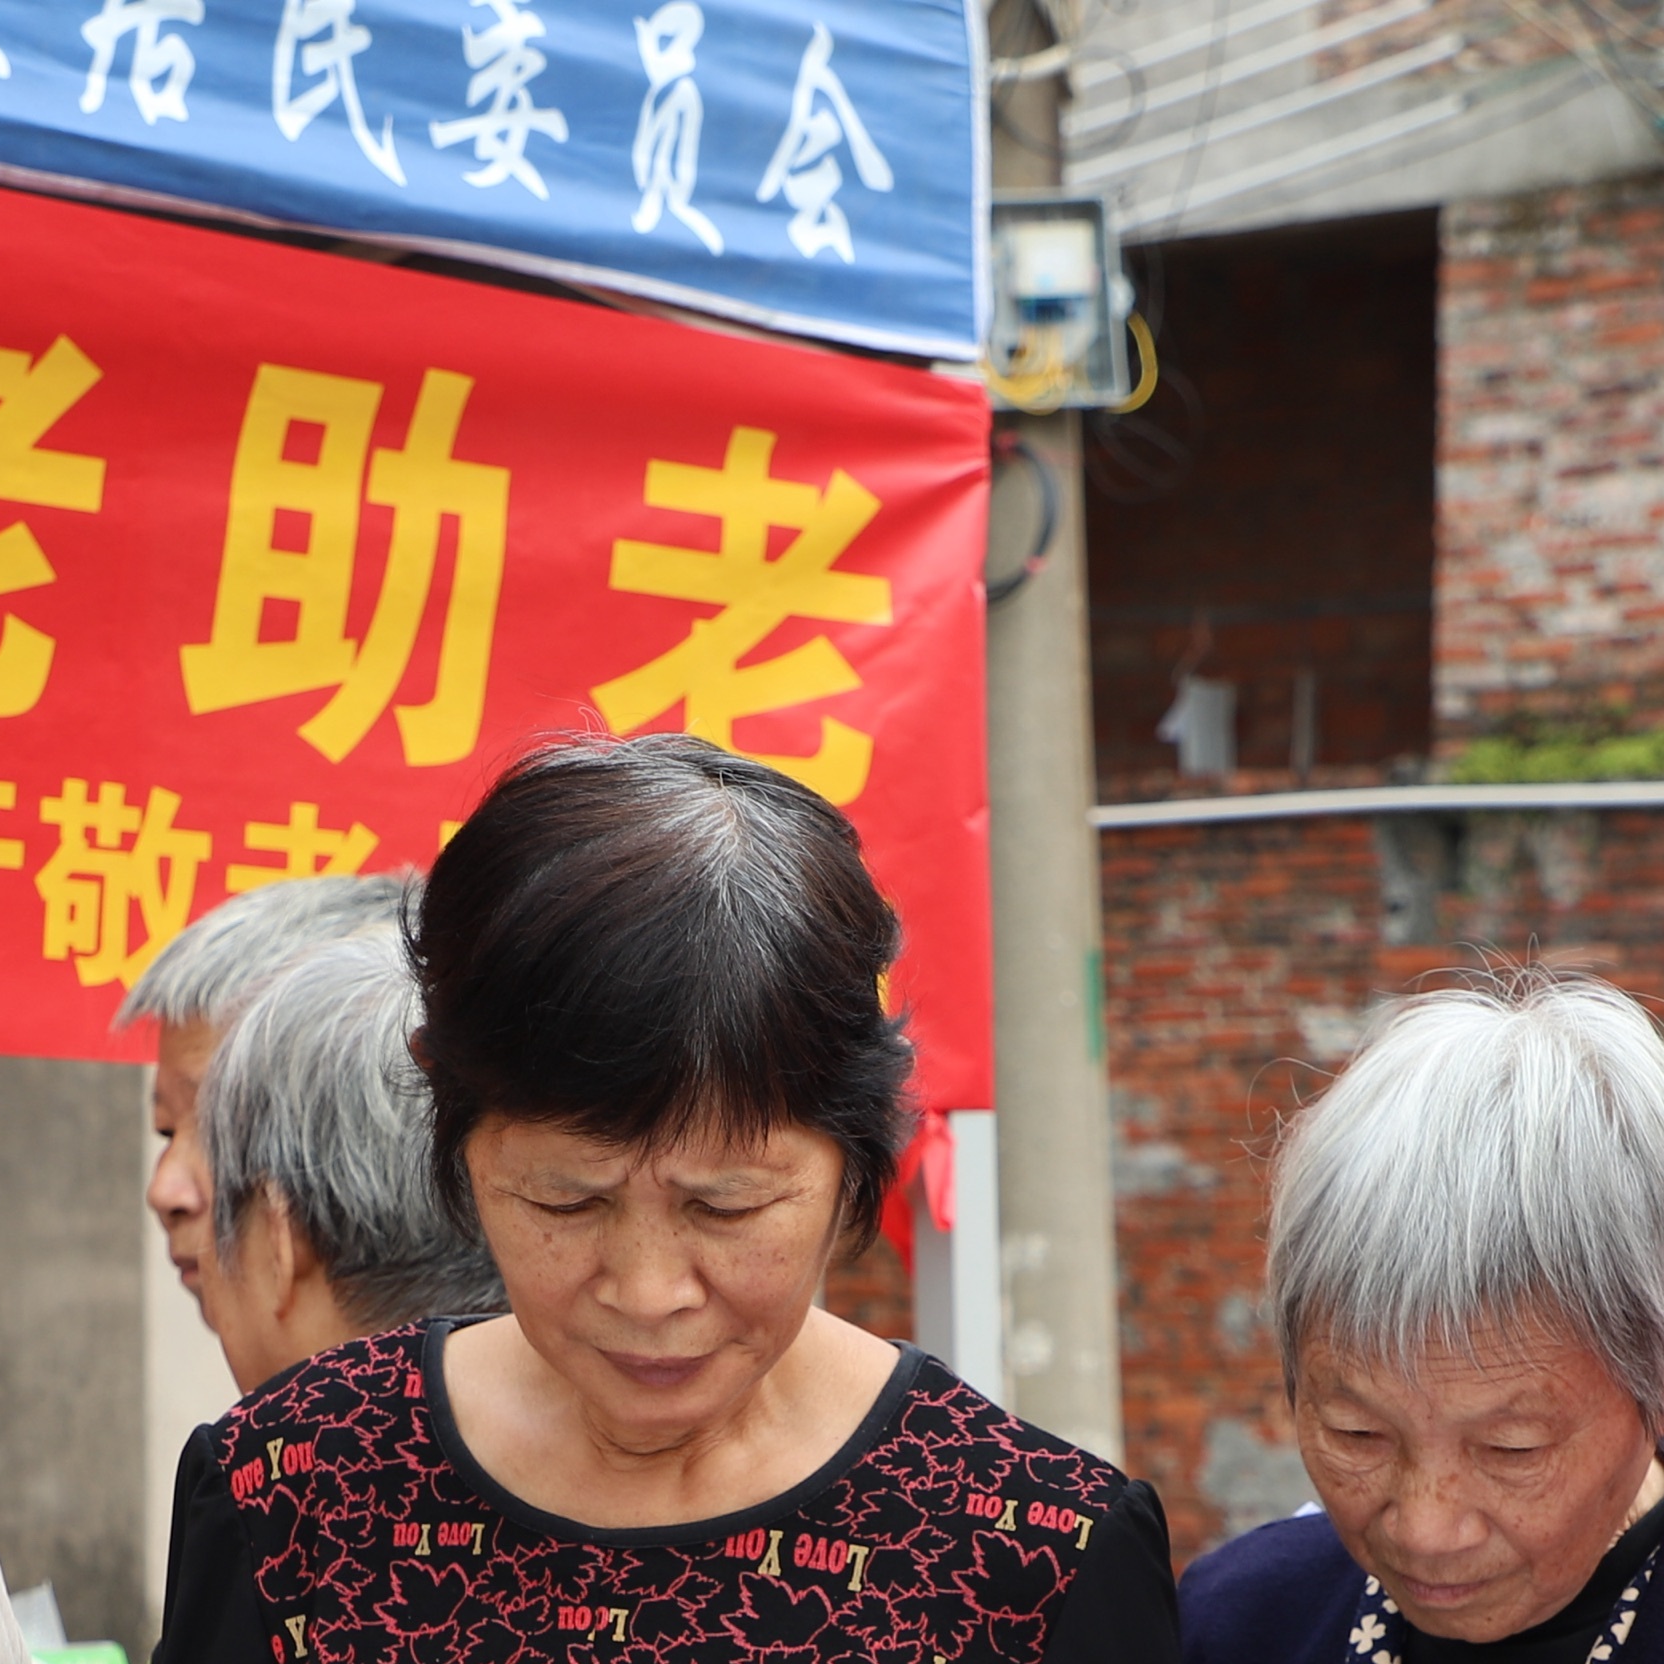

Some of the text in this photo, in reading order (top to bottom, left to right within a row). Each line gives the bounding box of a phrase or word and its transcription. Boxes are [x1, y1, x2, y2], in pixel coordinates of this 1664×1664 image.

[231, 1437, 314, 1501] ove You
[392, 1522, 486, 1556] Love You
[966, 1492, 1094, 1550] Love You
[724, 1527, 870, 1593] Love You
